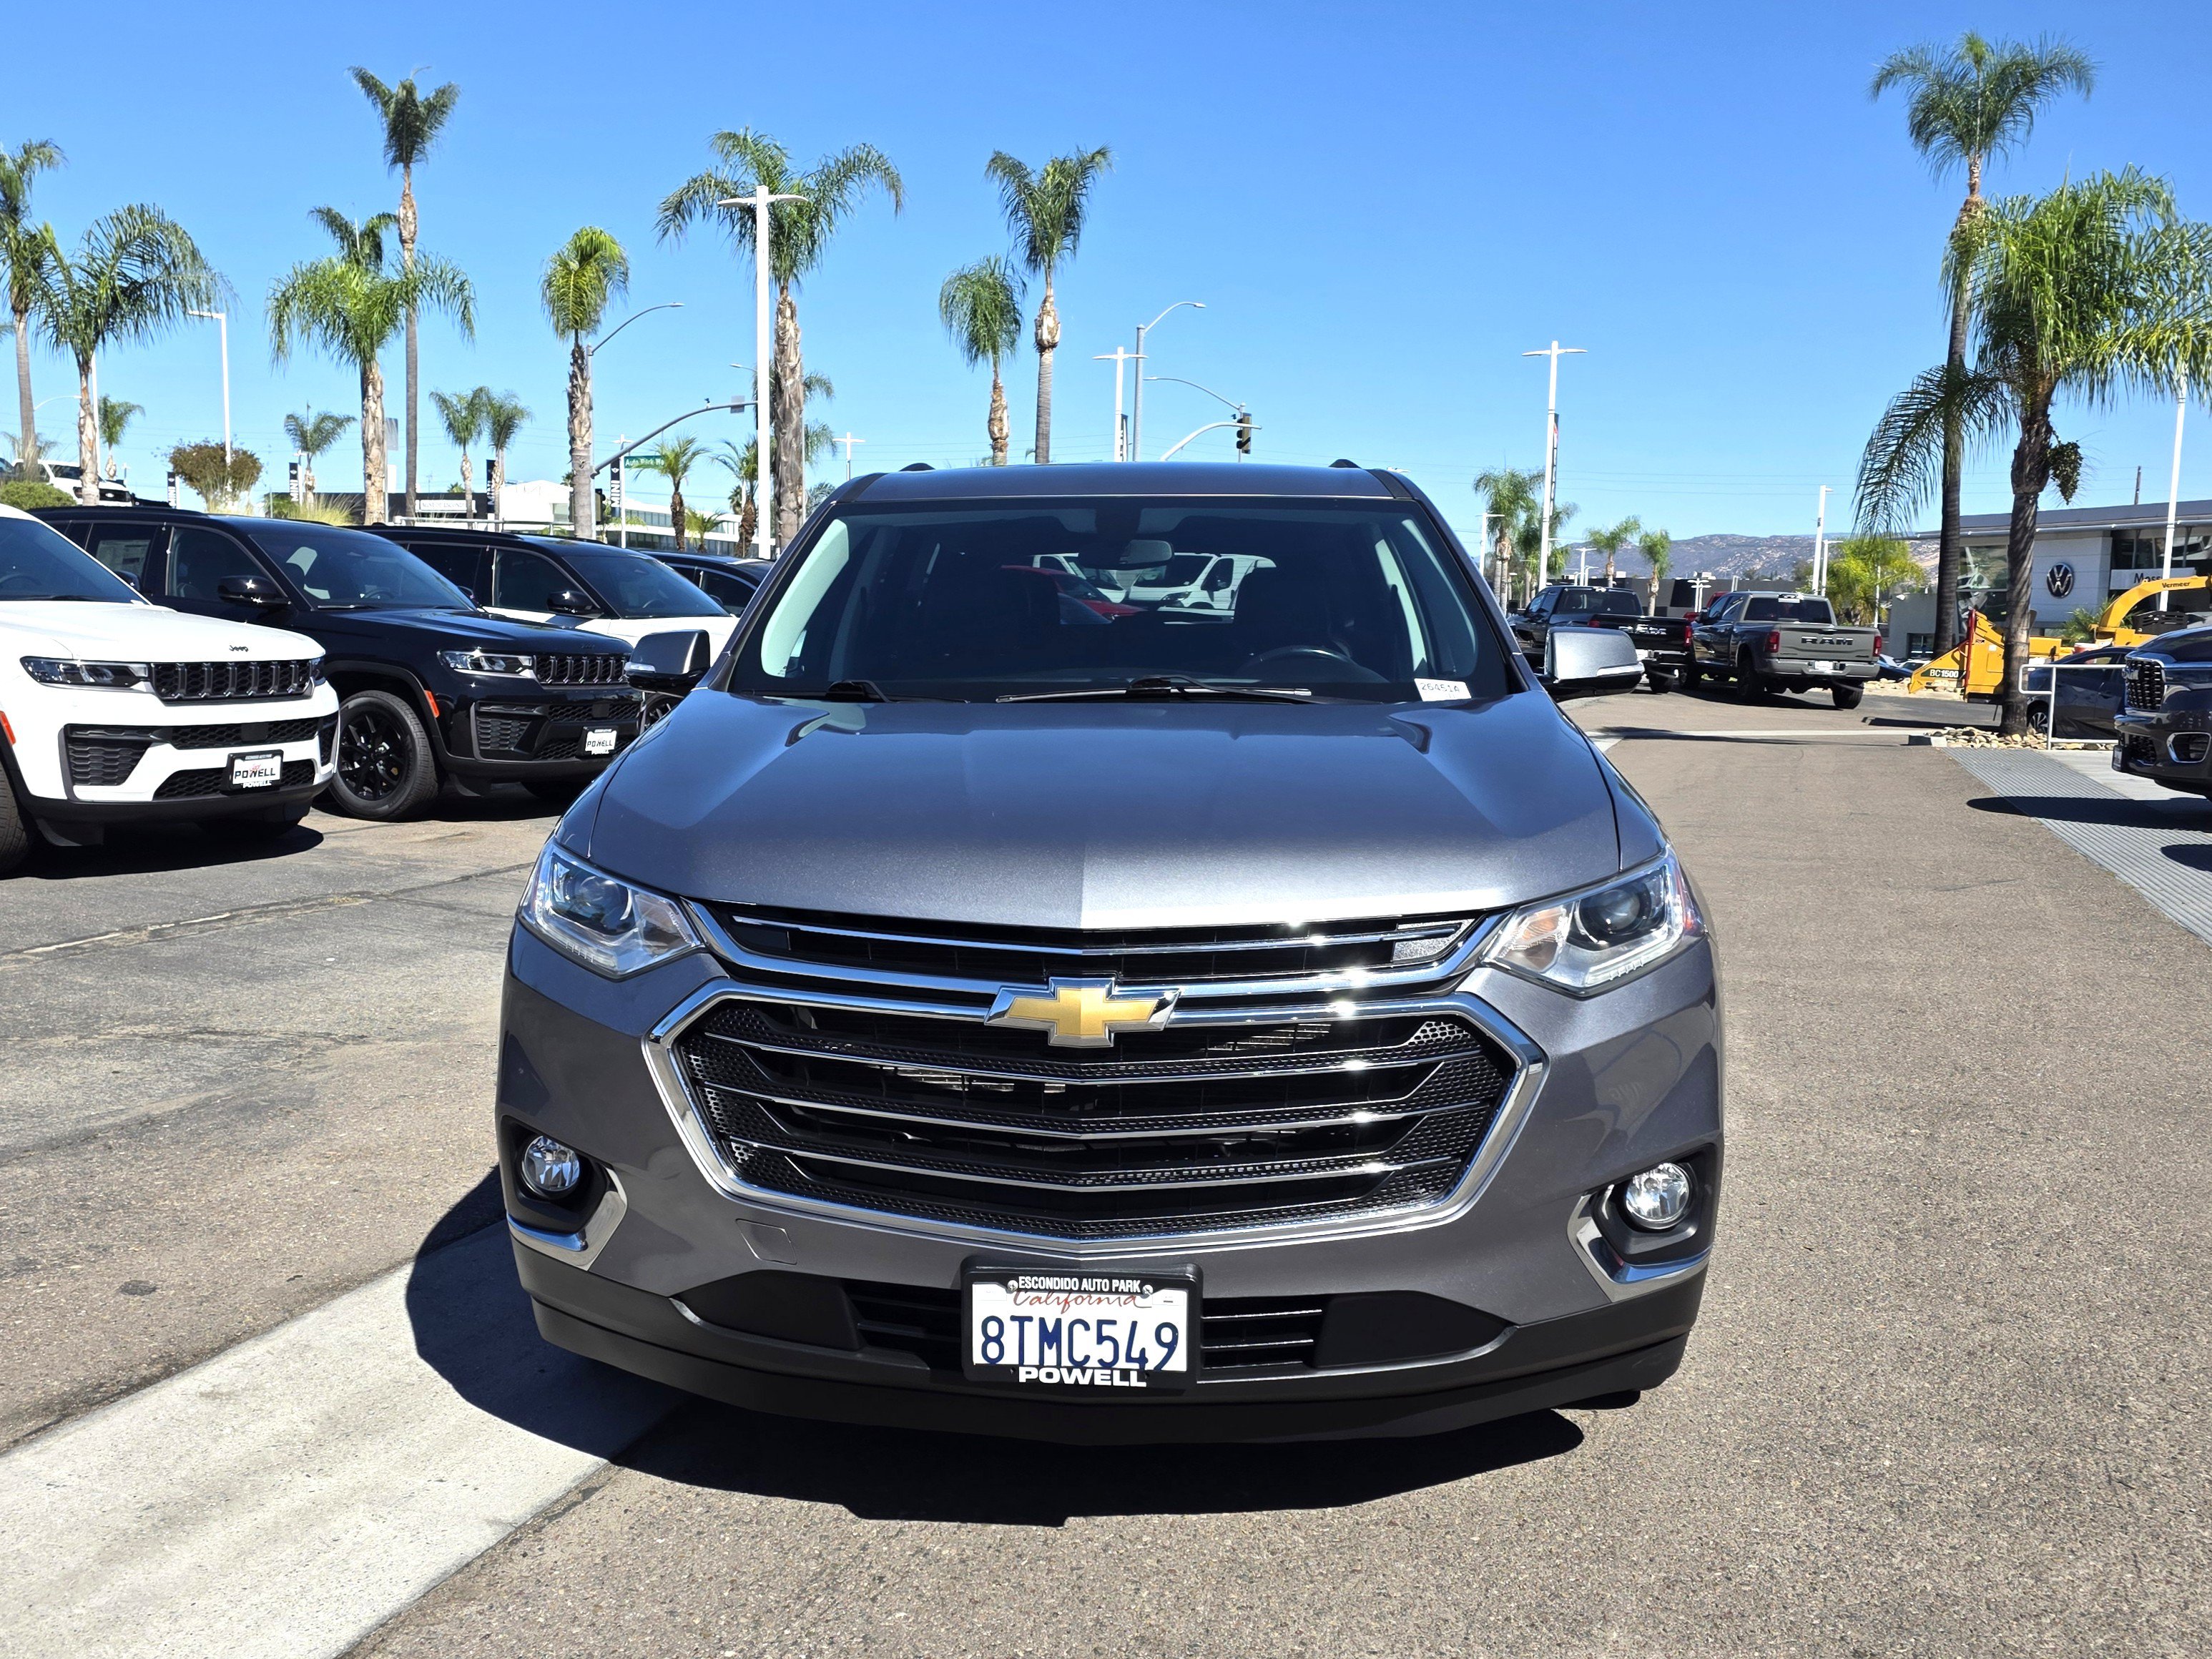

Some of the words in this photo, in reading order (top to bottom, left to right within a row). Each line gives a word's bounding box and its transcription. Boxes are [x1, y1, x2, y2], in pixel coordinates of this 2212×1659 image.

[167, 486, 177, 506] MINI
[289, 479, 299, 501] MINI
[610, 480, 620, 507] MINI
[2133, 573, 2163, 584] Moss
[1801, 635, 1854, 646] RAM
[234, 767, 276, 779] POWELL
[1018, 1276, 1080, 1291] ESCONDIDO
[1081, 1278, 1109, 1292] AUTO
[1112, 1279, 1141, 1293] PARK
[1013, 1289, 1152, 1314] California
[980, 1314, 1179, 1372] 8TMC549
[1018, 1367, 1147, 1387] POWELL
